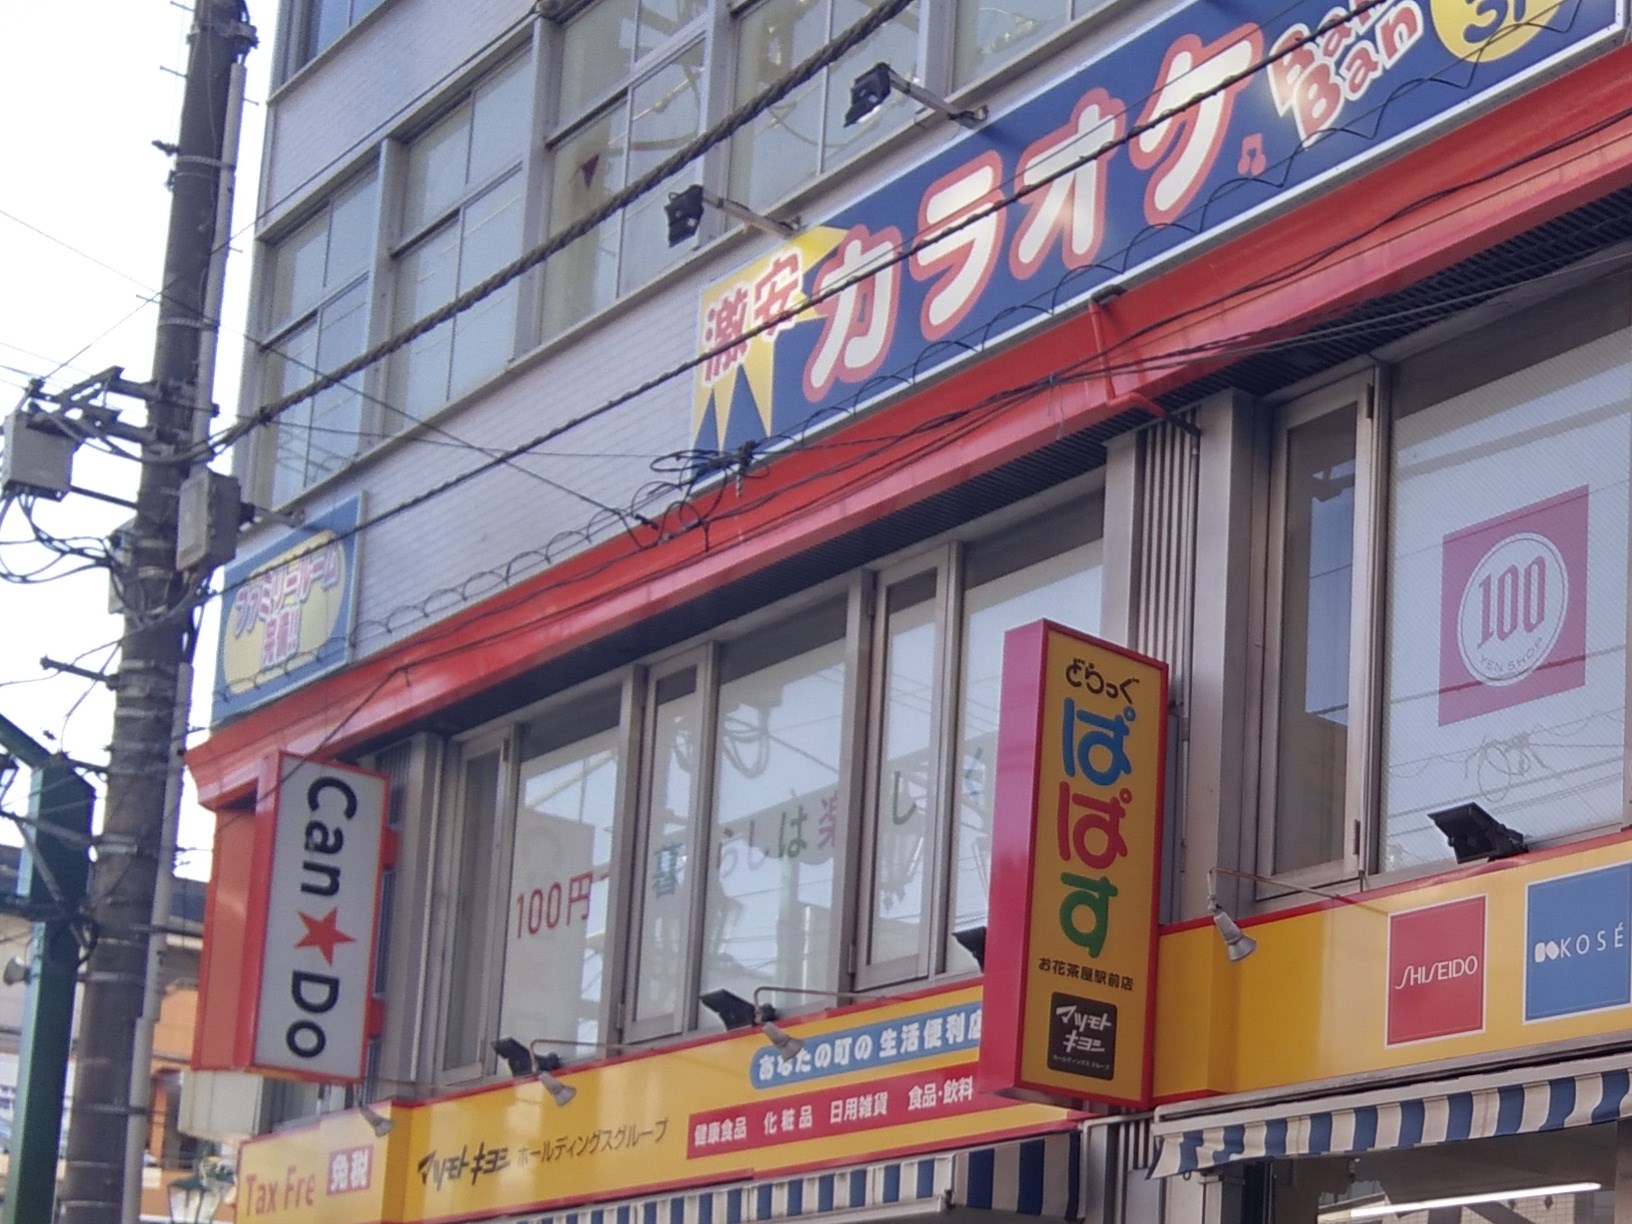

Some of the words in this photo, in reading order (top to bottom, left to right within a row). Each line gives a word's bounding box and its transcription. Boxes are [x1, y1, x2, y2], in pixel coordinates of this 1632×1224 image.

[1293, 2, 1421, 147] Ban
[701, 243, 801, 384] 激安
[803, 22, 1262, 400] カラオケ
[1477, 555, 1546, 649] 100
[1479, 654, 1503, 673] YEN
[1507, 635, 1543, 672] SHOP
[1065, 657, 1140, 706] どらっぐ
[299, 775, 358, 898] Can
[1056, 697, 1137, 958] ぱぱす
[517, 870, 594, 939] 100円
[1559, 925, 1625, 960] KOSÉ
[1038, 956, 1134, 992] お花茶屋駅前店
[1394, 954, 1479, 990] SHISEIDO
[1056, 1005, 1112, 1032] マツモト
[694, 1116, 747, 1147] 健康食品
[764, 1104, 813, 1136] 化粧品
[830, 1091, 888, 1126] 日用雑貨
[245, 1172, 279, 1218] Tax
[329, 1150, 370, 1193] 免税
